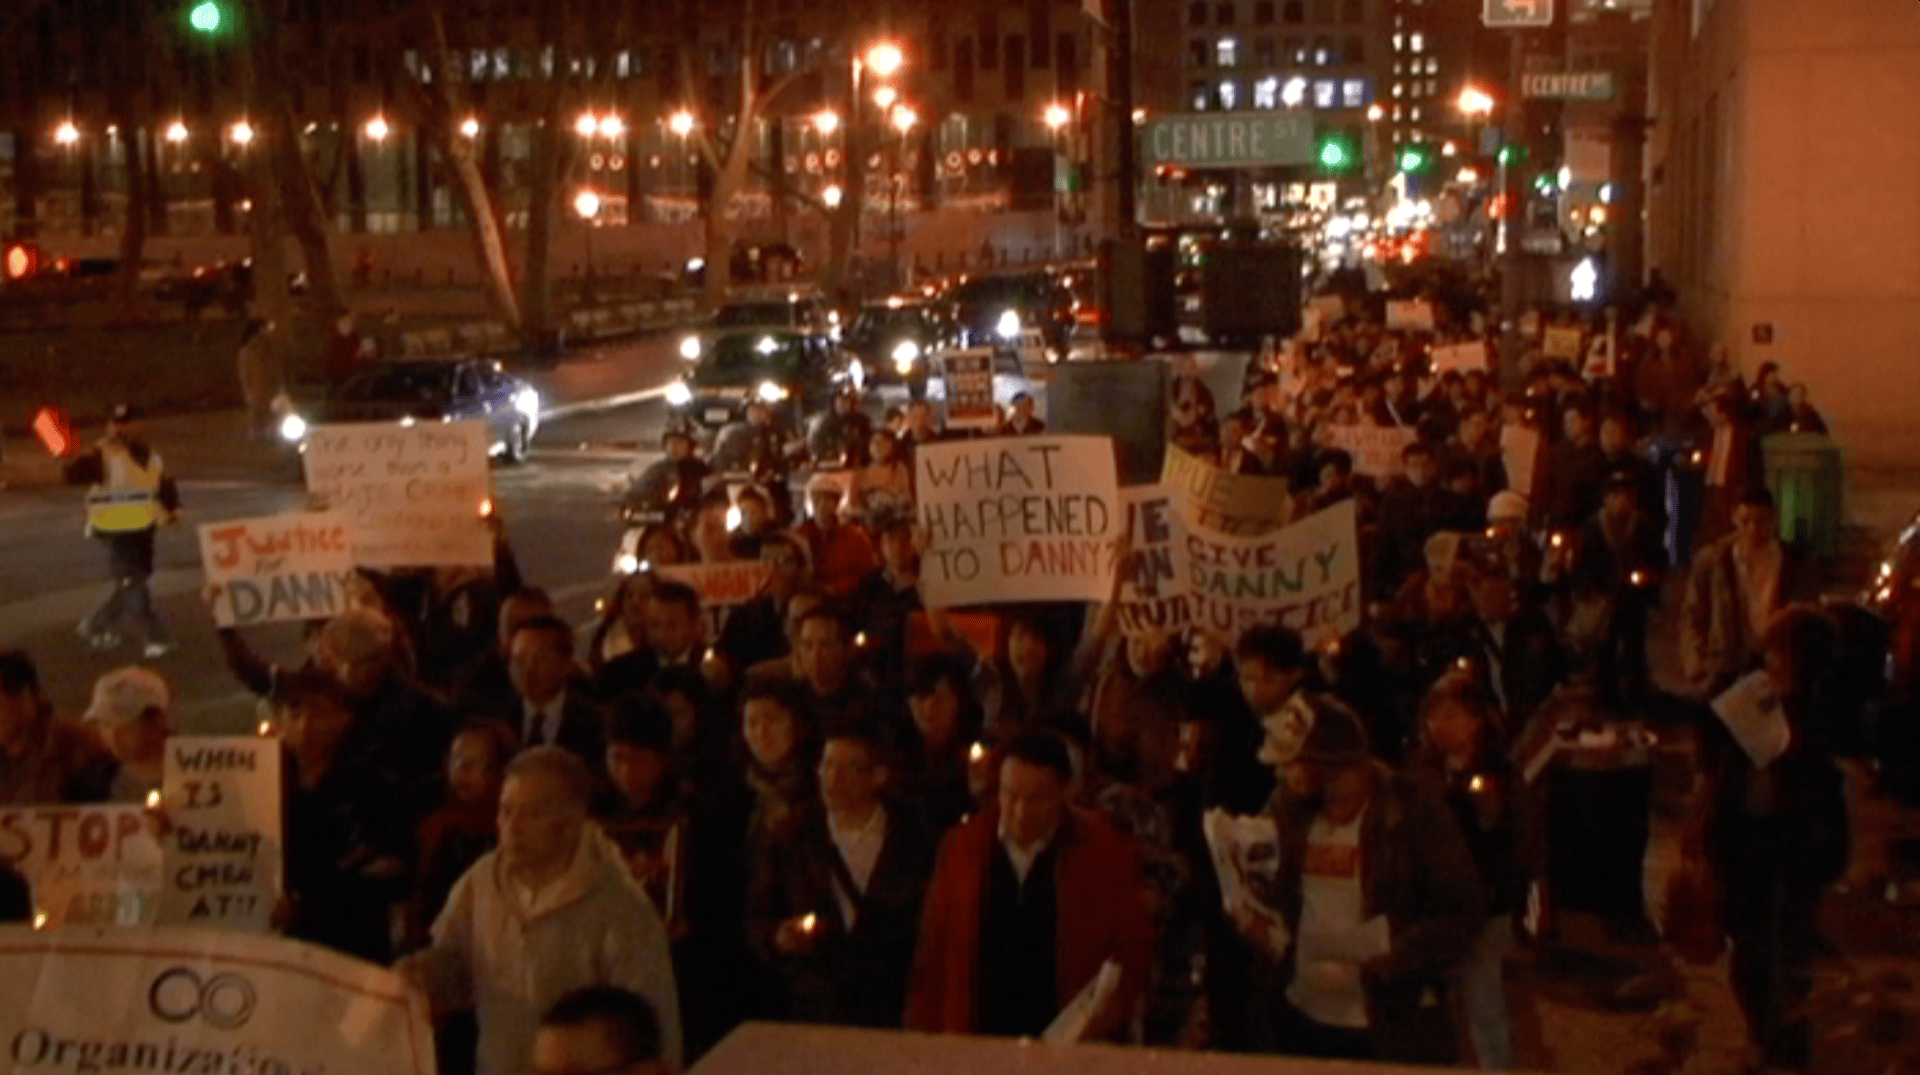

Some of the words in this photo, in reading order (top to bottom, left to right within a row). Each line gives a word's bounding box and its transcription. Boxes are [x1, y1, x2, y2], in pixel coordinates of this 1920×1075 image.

[1154, 121, 1265, 160] CENTRE
[1275, 119, 1299, 139] ST
[925, 442, 1061, 490] WHAT
[924, 494, 1109, 541] HAPPENED
[930, 547, 980, 581] TO
[1187, 534, 1275, 568] GIVE
[1188, 543, 1339, 599] DANNY
[226, 565, 354, 620] DANNY
[183, 781, 223, 808] IS
[0, 812, 142, 865] STOP
